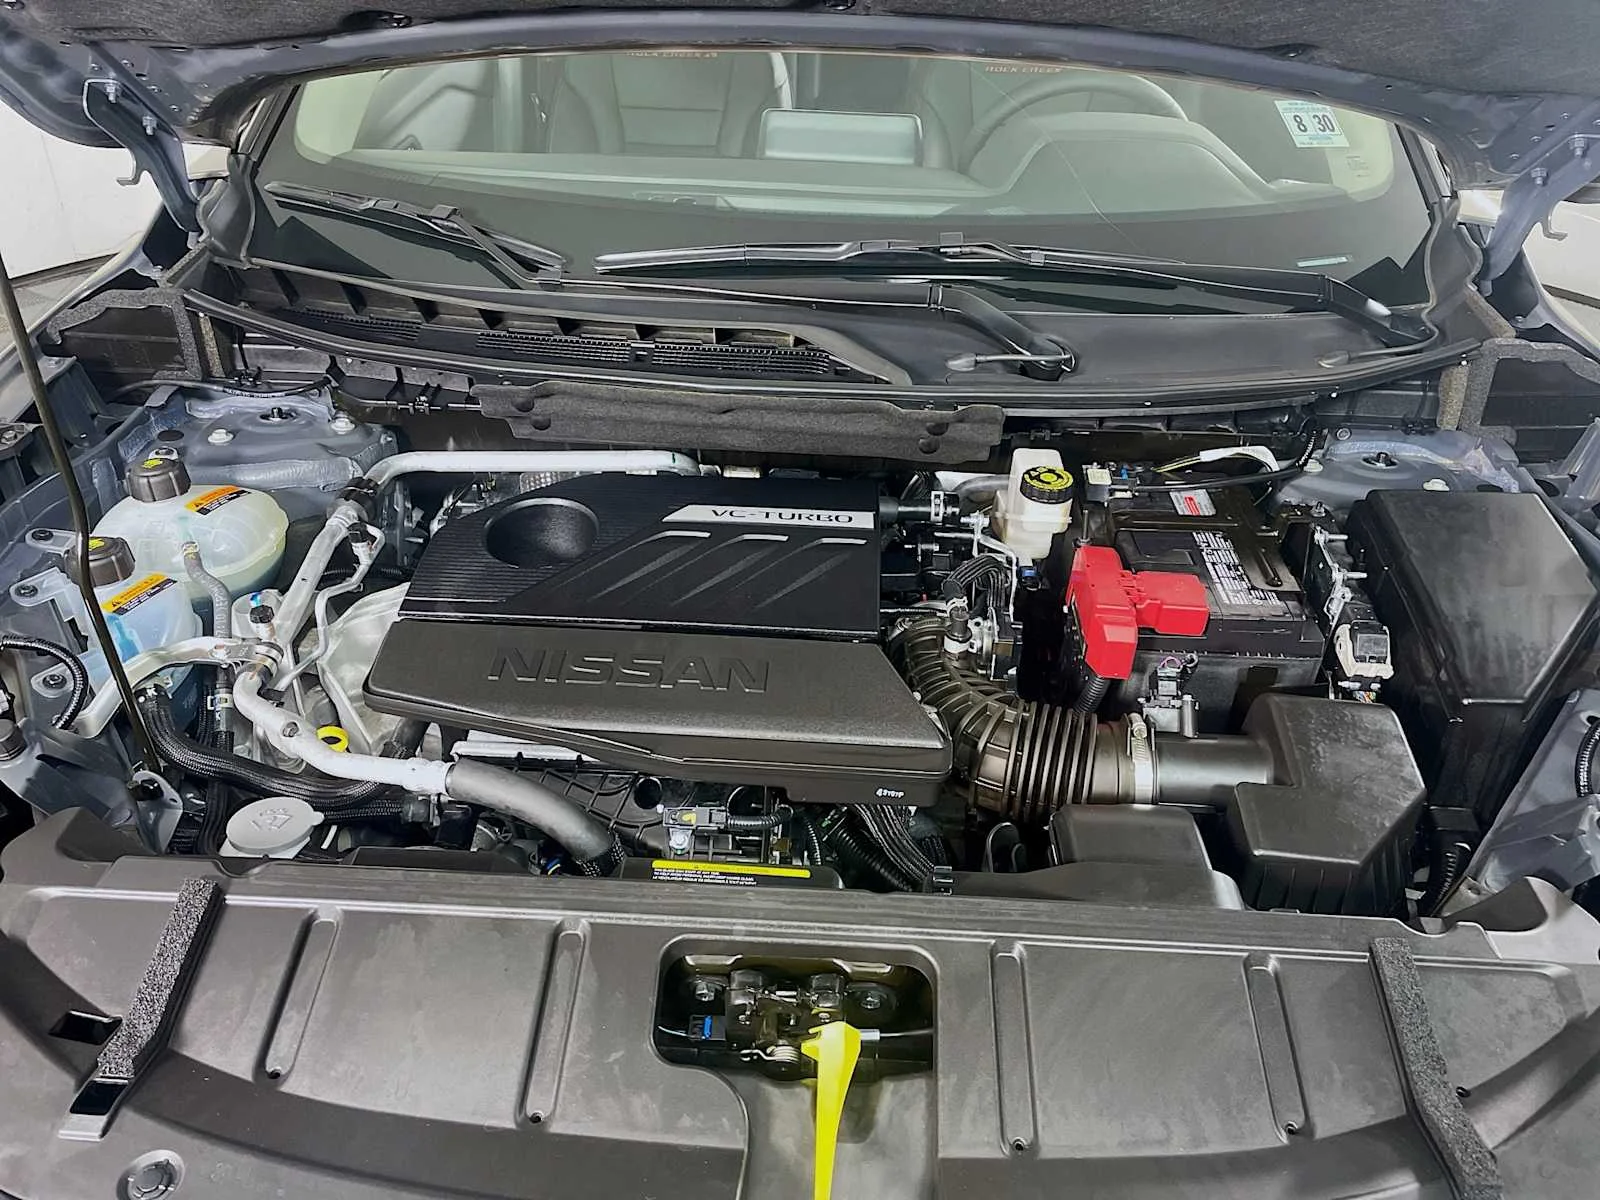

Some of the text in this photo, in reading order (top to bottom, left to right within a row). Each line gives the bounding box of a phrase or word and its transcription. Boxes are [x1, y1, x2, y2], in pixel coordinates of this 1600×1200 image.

[1293, 114, 1336, 133] 8 30
[711, 508, 853, 523] VC-TURBO
[487, 648, 769, 692] NISSAN
